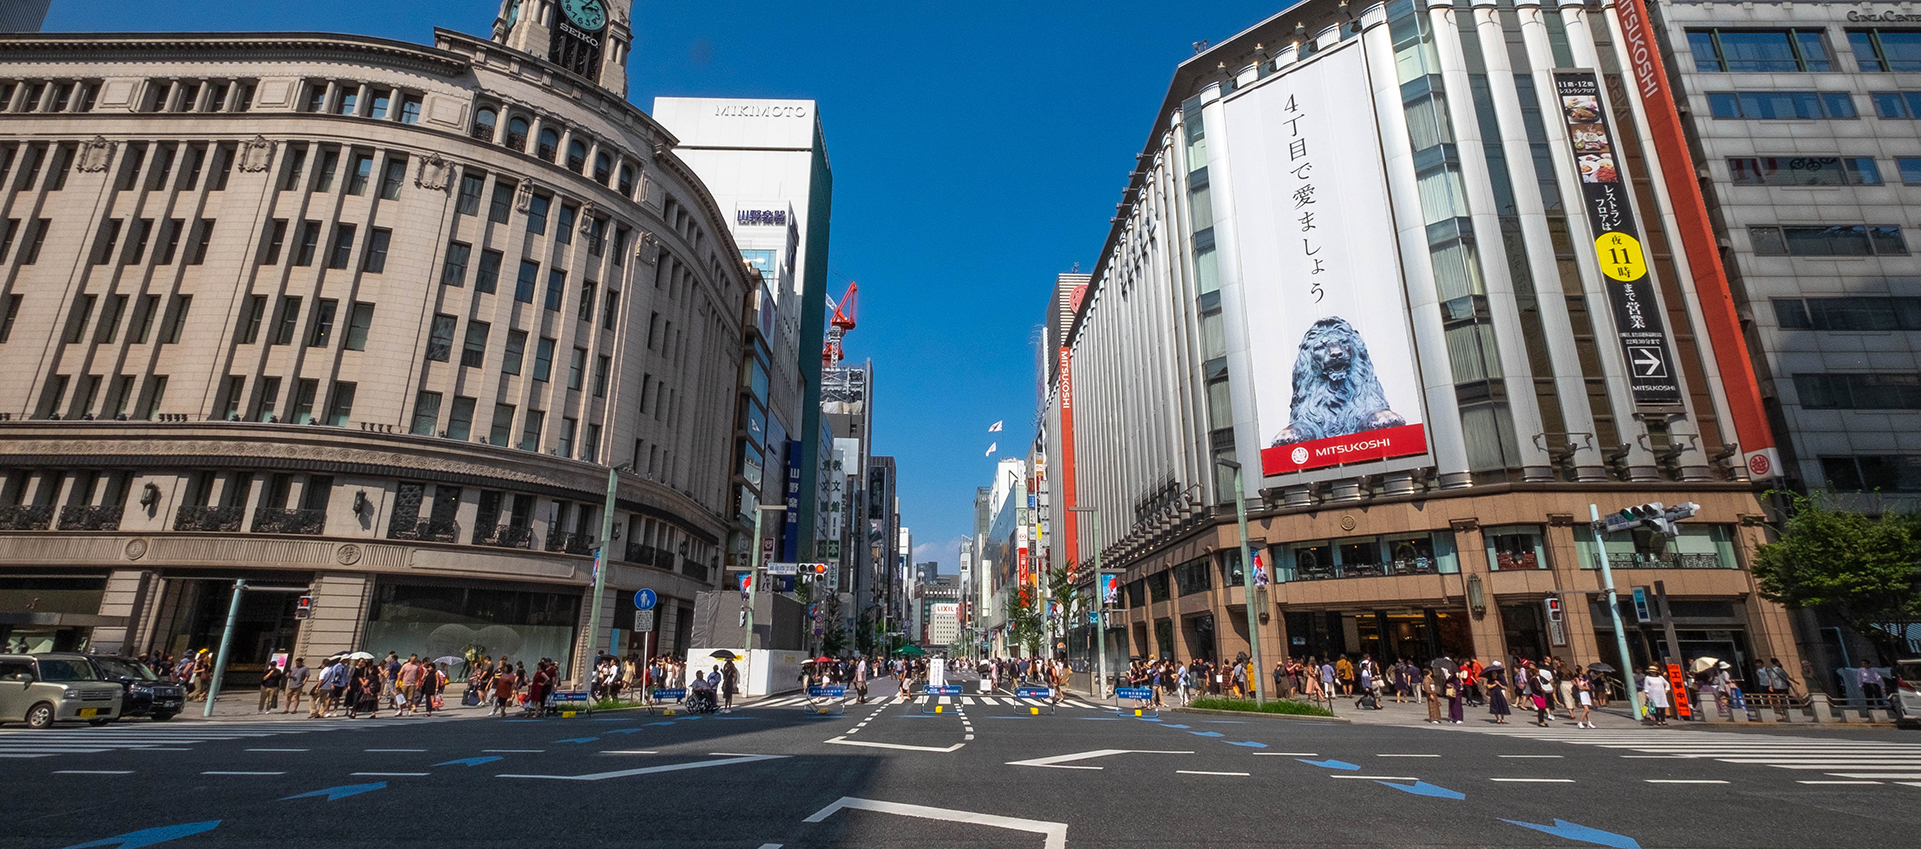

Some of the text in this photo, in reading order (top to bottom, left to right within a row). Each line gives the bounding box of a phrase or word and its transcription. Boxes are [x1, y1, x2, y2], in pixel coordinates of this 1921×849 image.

[559, 22, 599, 47] SEIKO
[1618, 0, 1659, 98] ITSUKOSHI
[715, 104, 806, 118] MIKIMOTO
[737, 209, 787, 224] 山野楽器
[1282, 93, 1325, 304] 4丁目で愛ましょう
[1595, 198, 1612, 231] フロアは
[1603, 184, 1622, 226] レストラン
[1623, 282, 1646, 329] まで営業
[1060, 349, 1070, 409] MITSUKOSHI
[1315, 437, 1391, 457] MITSUKOSHI
[787, 467, 800, 523] 山野楽器
[831, 459, 842, 513] 教文館
[829, 542, 838, 556] 本
